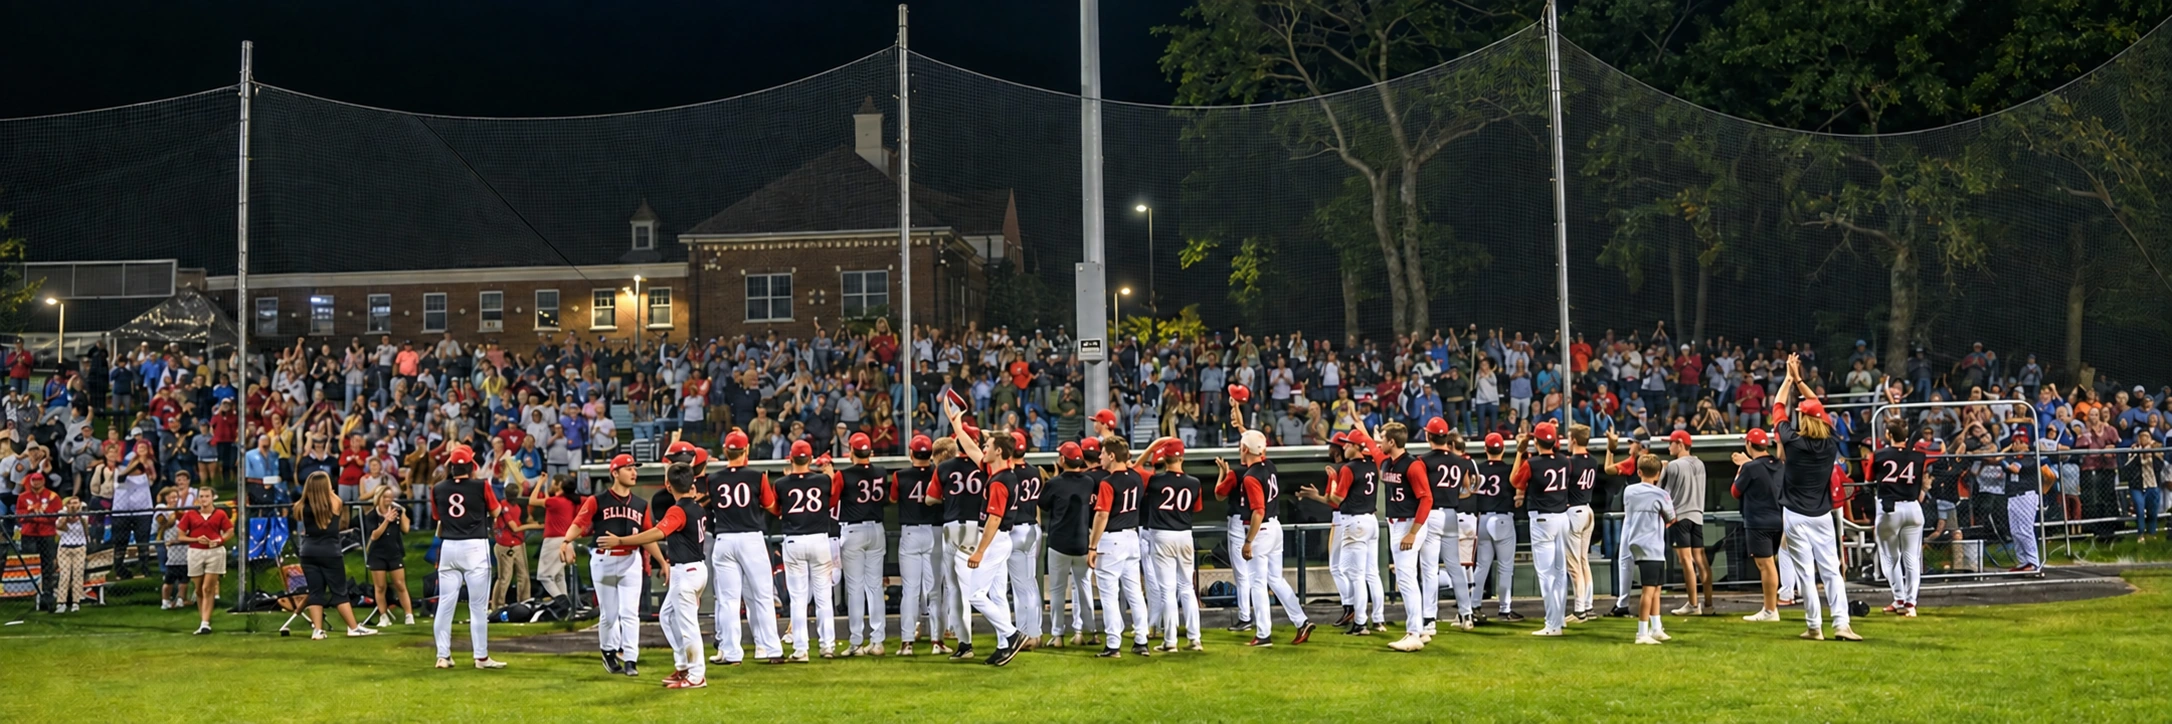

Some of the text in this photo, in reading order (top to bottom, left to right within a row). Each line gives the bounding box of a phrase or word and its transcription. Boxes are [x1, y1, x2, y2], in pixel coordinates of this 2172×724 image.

[949, 469, 982, 495] 36
[1437, 464, 1461, 488] 29
[1478, 474, 1501, 496] 23
[1543, 466, 1567, 492] 21
[1577, 468, 1595, 490] 40
[1882, 460, 1916, 485] 24
[717, 482, 751, 509] 30
[787, 487, 822, 514] 28
[856, 477, 884, 503] 35
[1020, 477, 1041, 502] 32
[1119, 486, 1138, 514] 11
[1158, 486, 1192, 512] 20
[448, 493, 465, 518] 8
